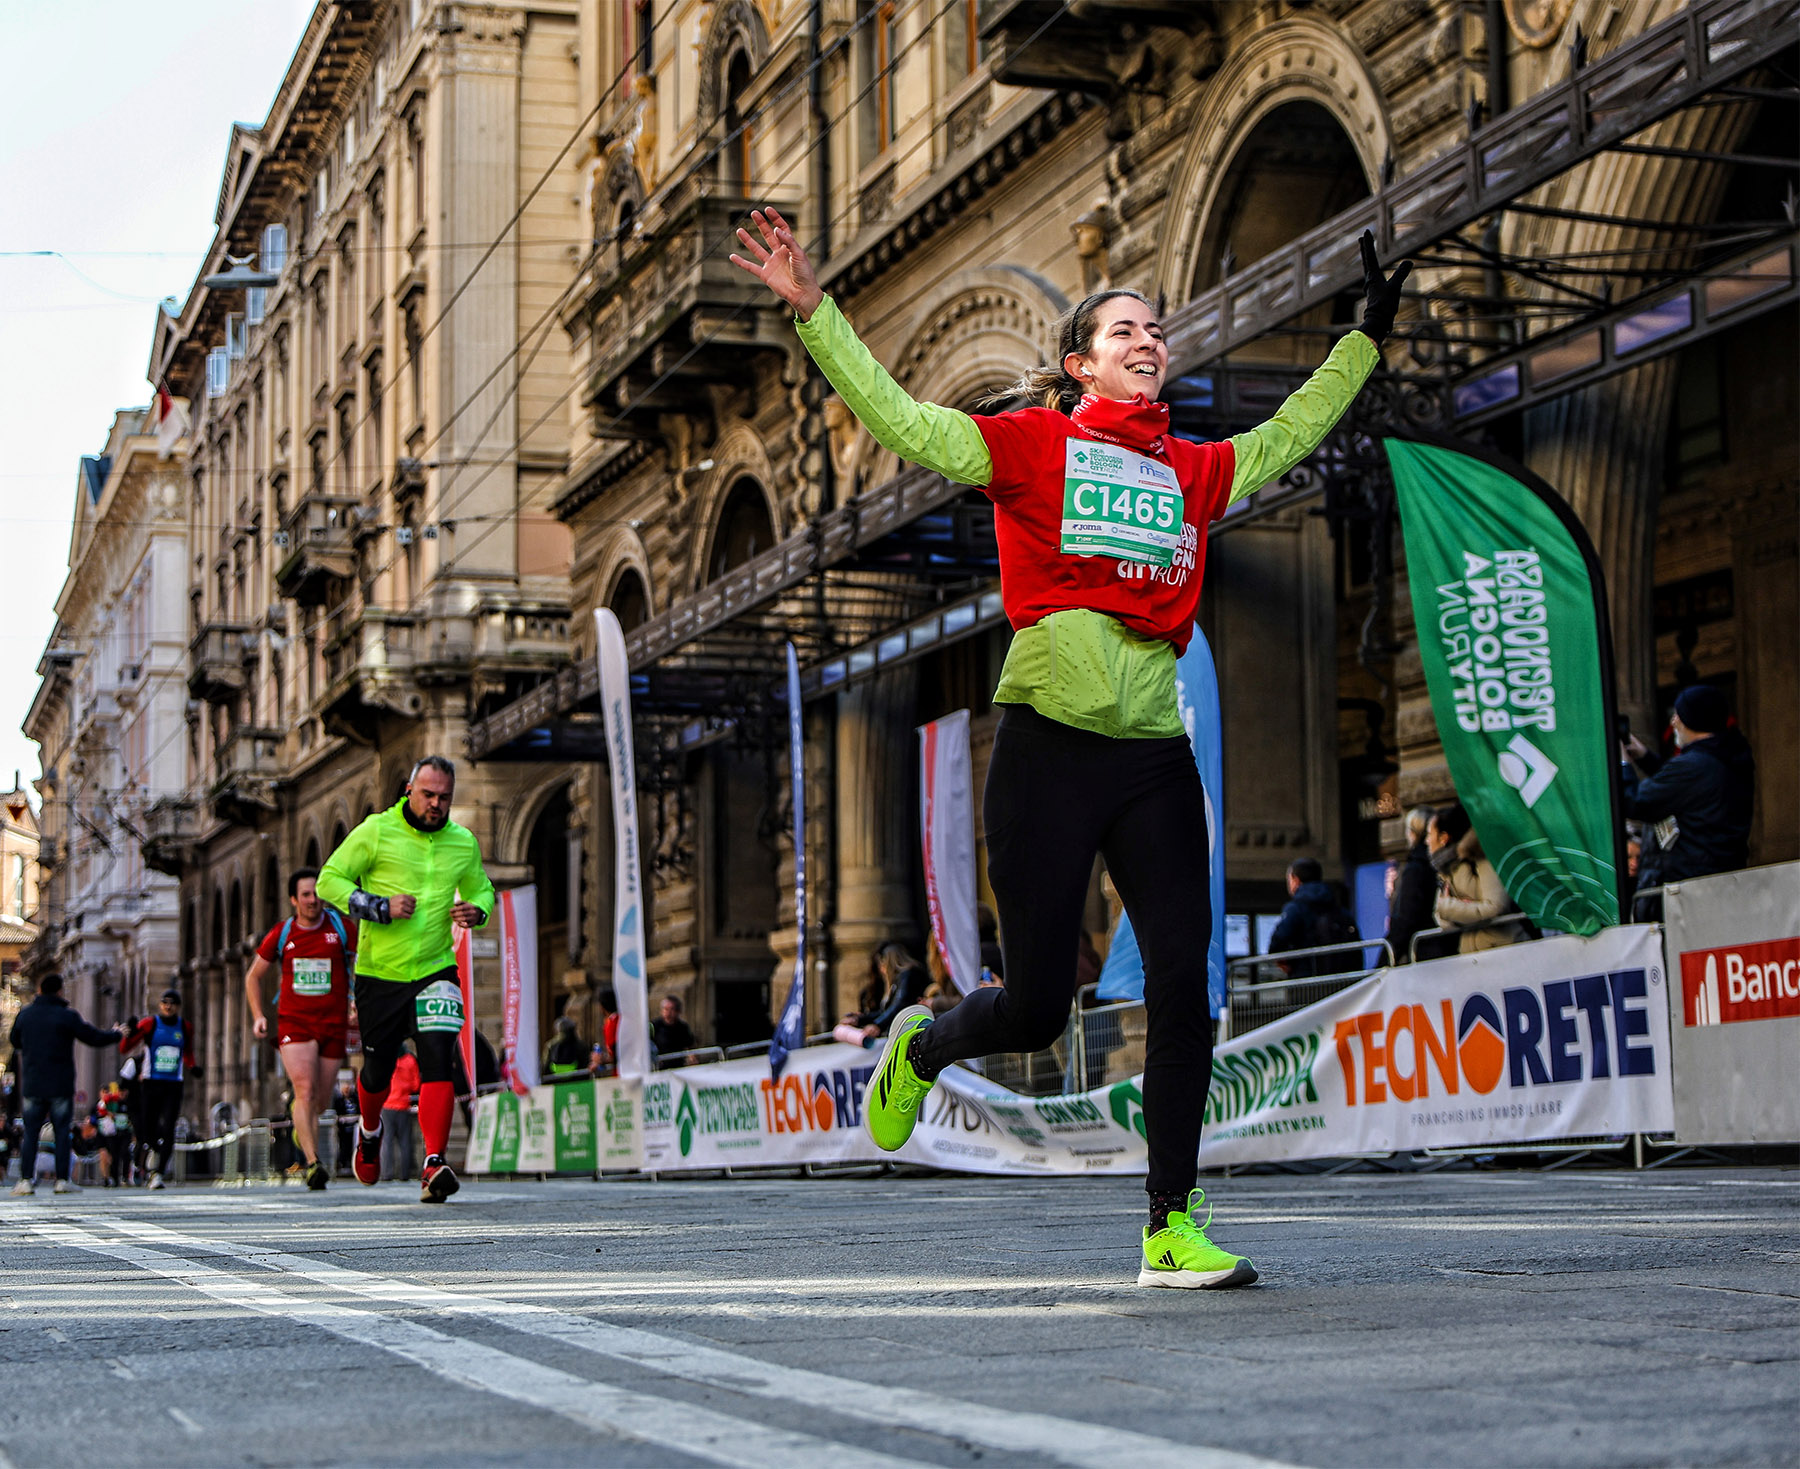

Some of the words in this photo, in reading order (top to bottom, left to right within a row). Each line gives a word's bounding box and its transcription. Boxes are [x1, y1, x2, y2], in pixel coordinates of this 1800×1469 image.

[1090, 460, 1123, 470] BOLOGNA
[1073, 482, 1174, 529] C1465
[1726, 952, 1800, 1004] Banc
[425, 1000, 459, 1017] C712
[1333, 967, 1656, 1106] TECNORETE
[1266, 1114, 1326, 1136] NETWORK
